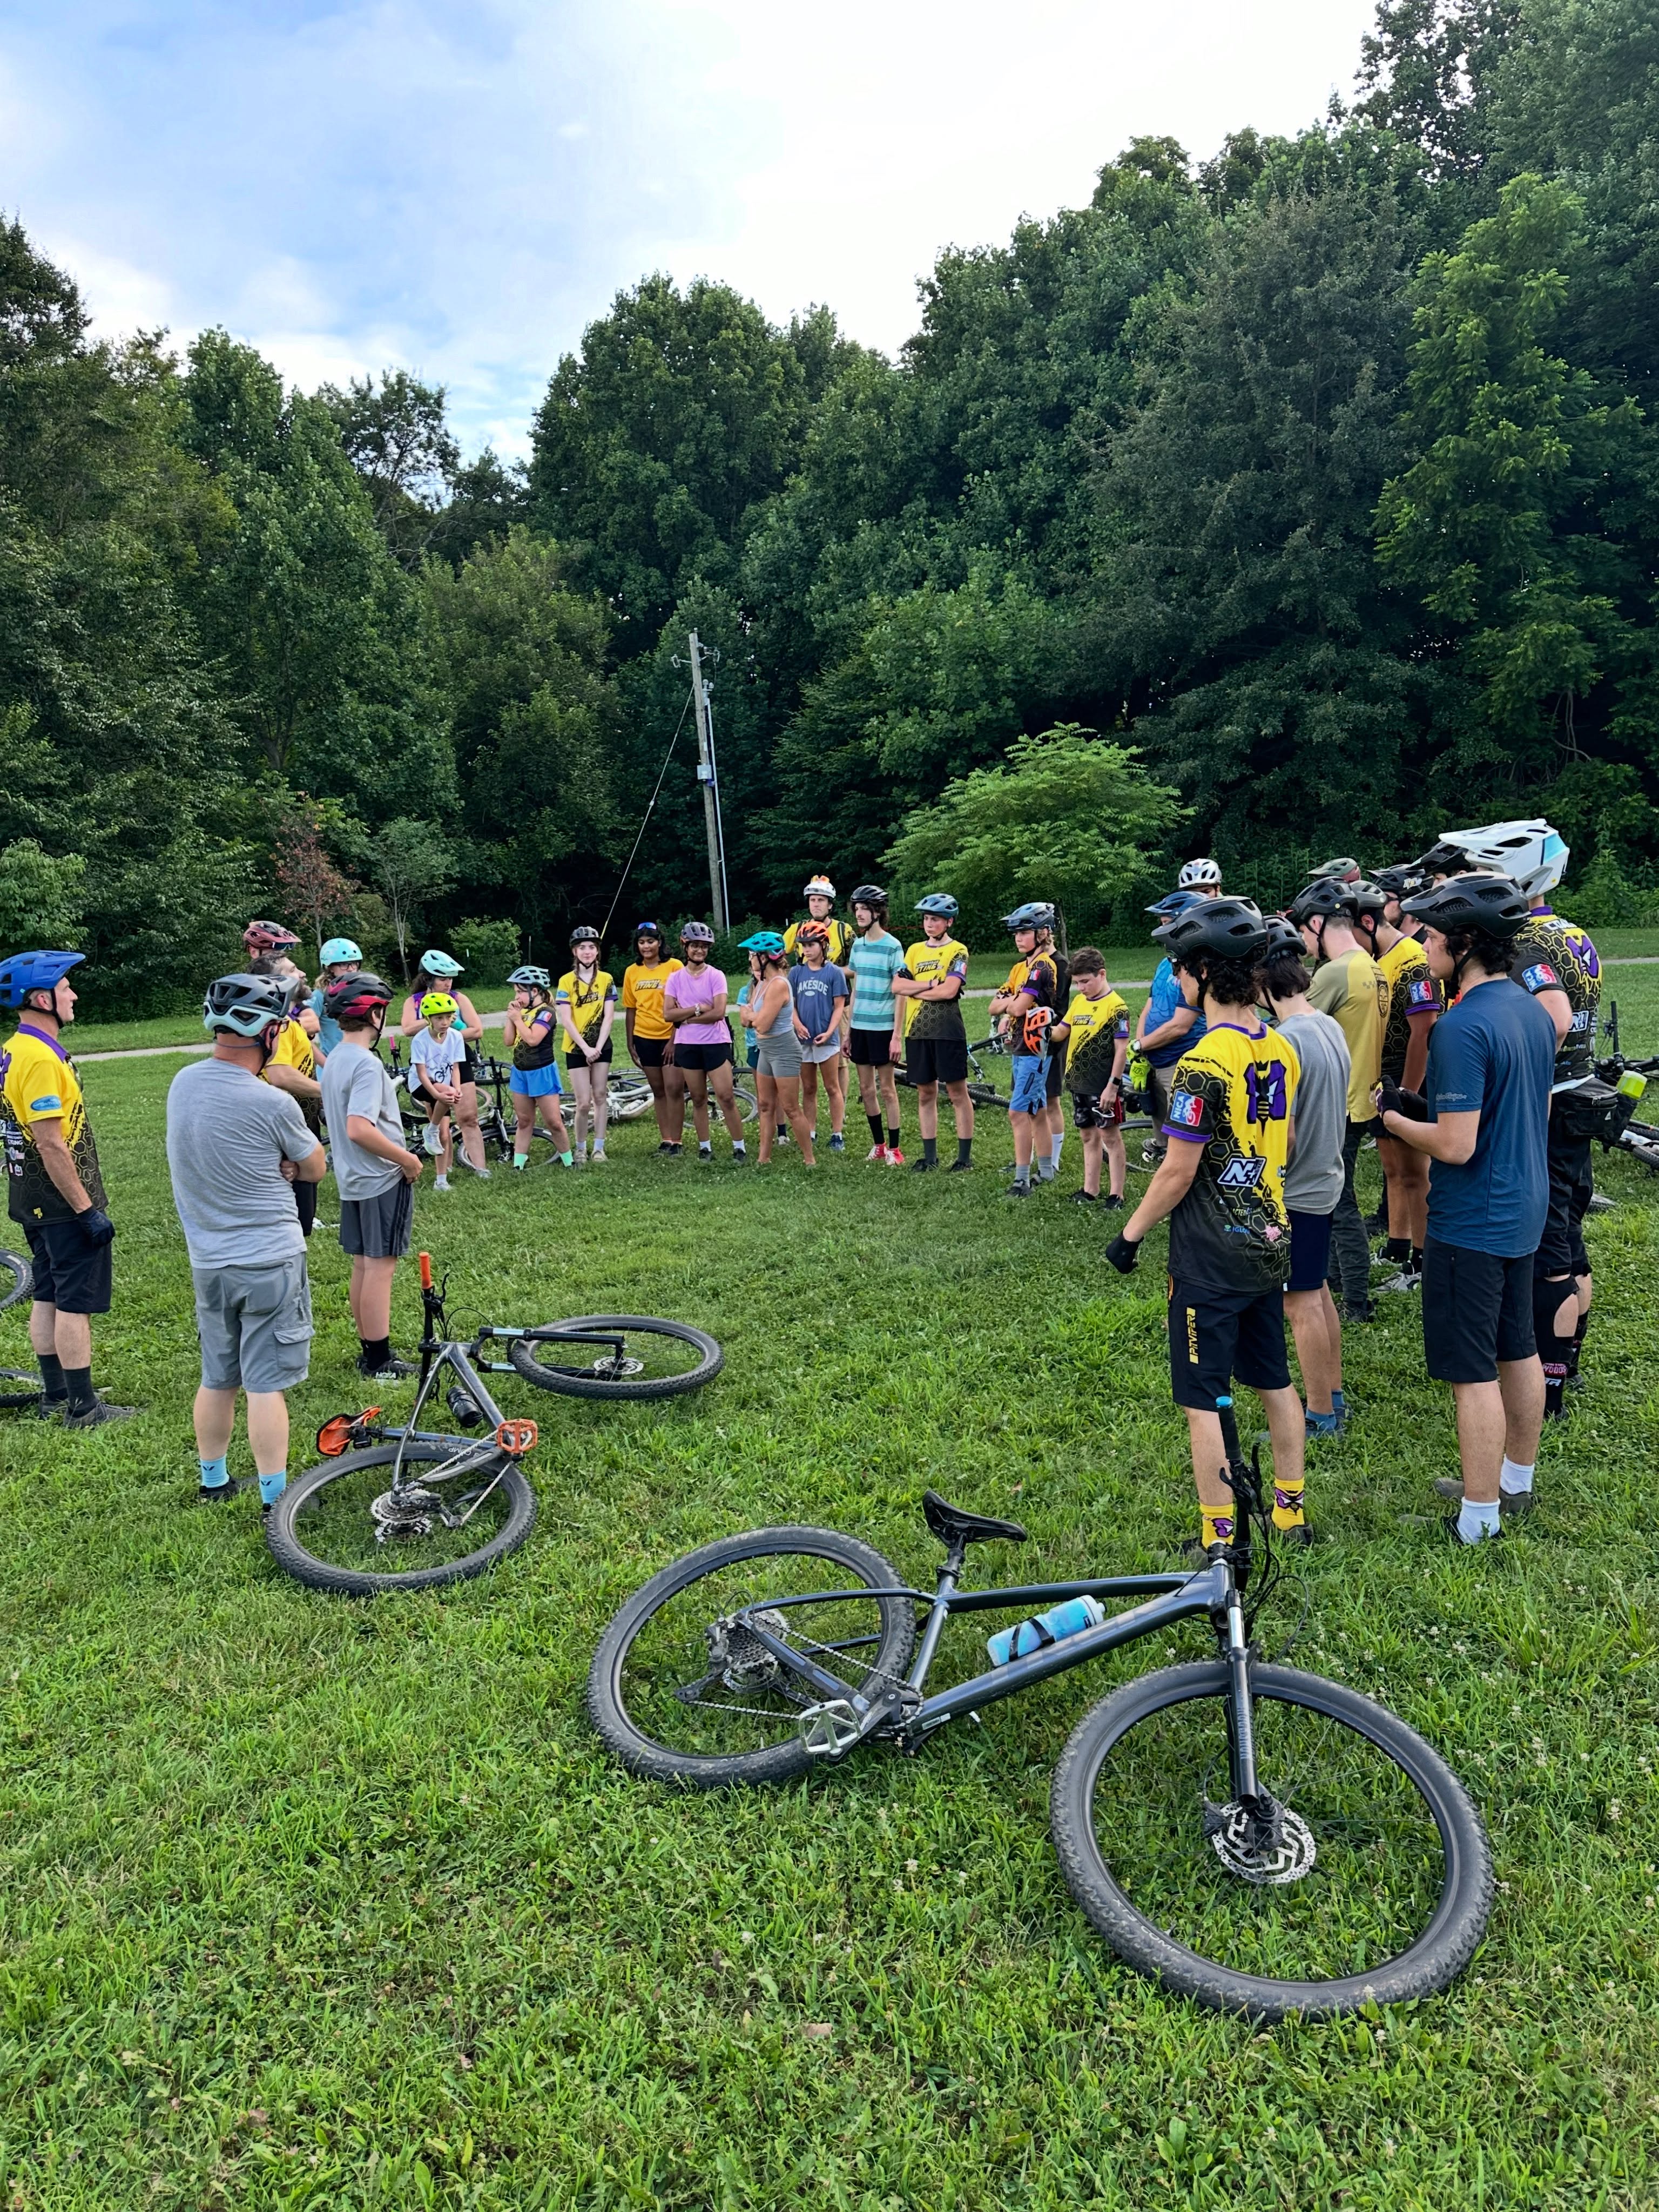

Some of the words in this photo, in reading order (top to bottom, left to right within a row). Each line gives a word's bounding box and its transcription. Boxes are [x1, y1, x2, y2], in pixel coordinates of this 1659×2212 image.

[798, 980, 828, 995] AKESIDE
[1173, 1096, 1185, 1119] NICA
[1141, 1925, 1181, 1954] COMP
